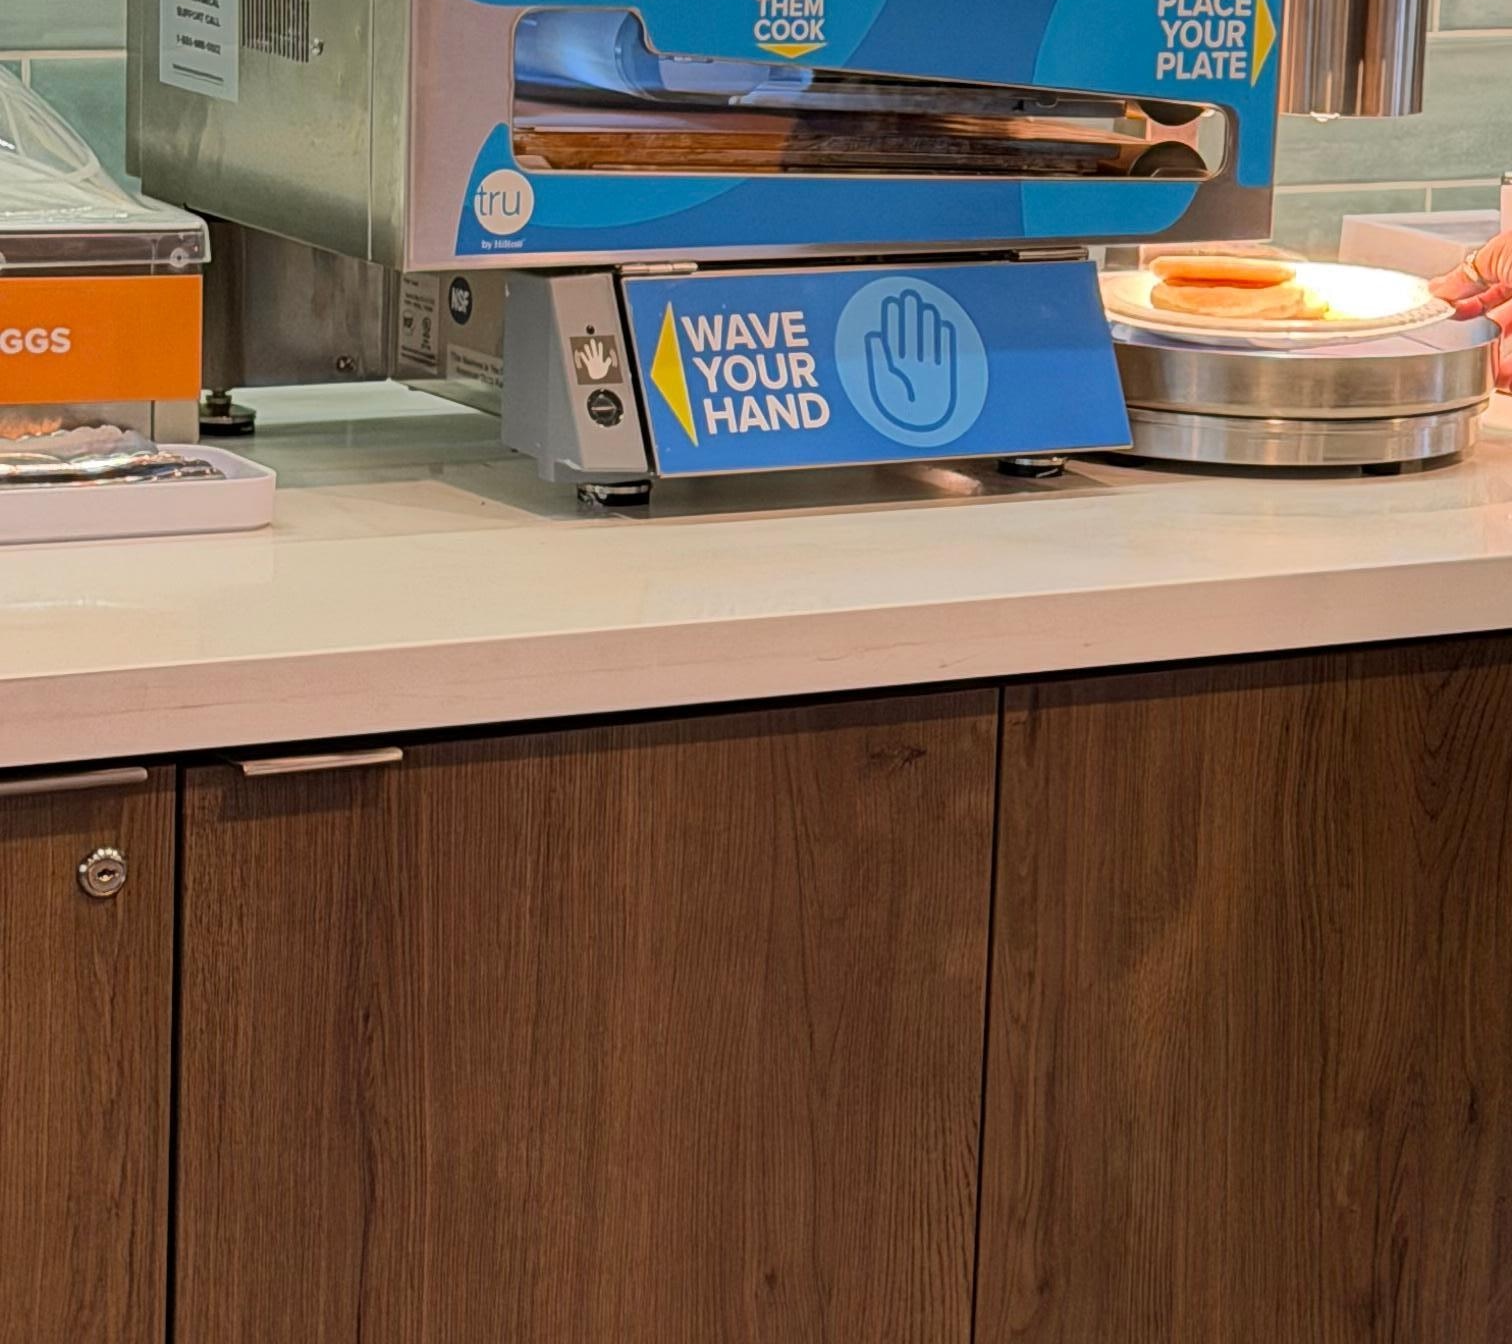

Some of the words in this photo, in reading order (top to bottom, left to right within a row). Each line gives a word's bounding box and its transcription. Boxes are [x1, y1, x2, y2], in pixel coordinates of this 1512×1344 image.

[753, 18, 827, 42] COOK
[1160, 18, 1247, 49] YOUR
[1155, 51, 1248, 81] PLATE
[475, 185, 522, 217] tru
[681, 310, 810, 353] WAVE
[691, 351, 820, 394] YOUR
[702, 391, 831, 436] HAND
